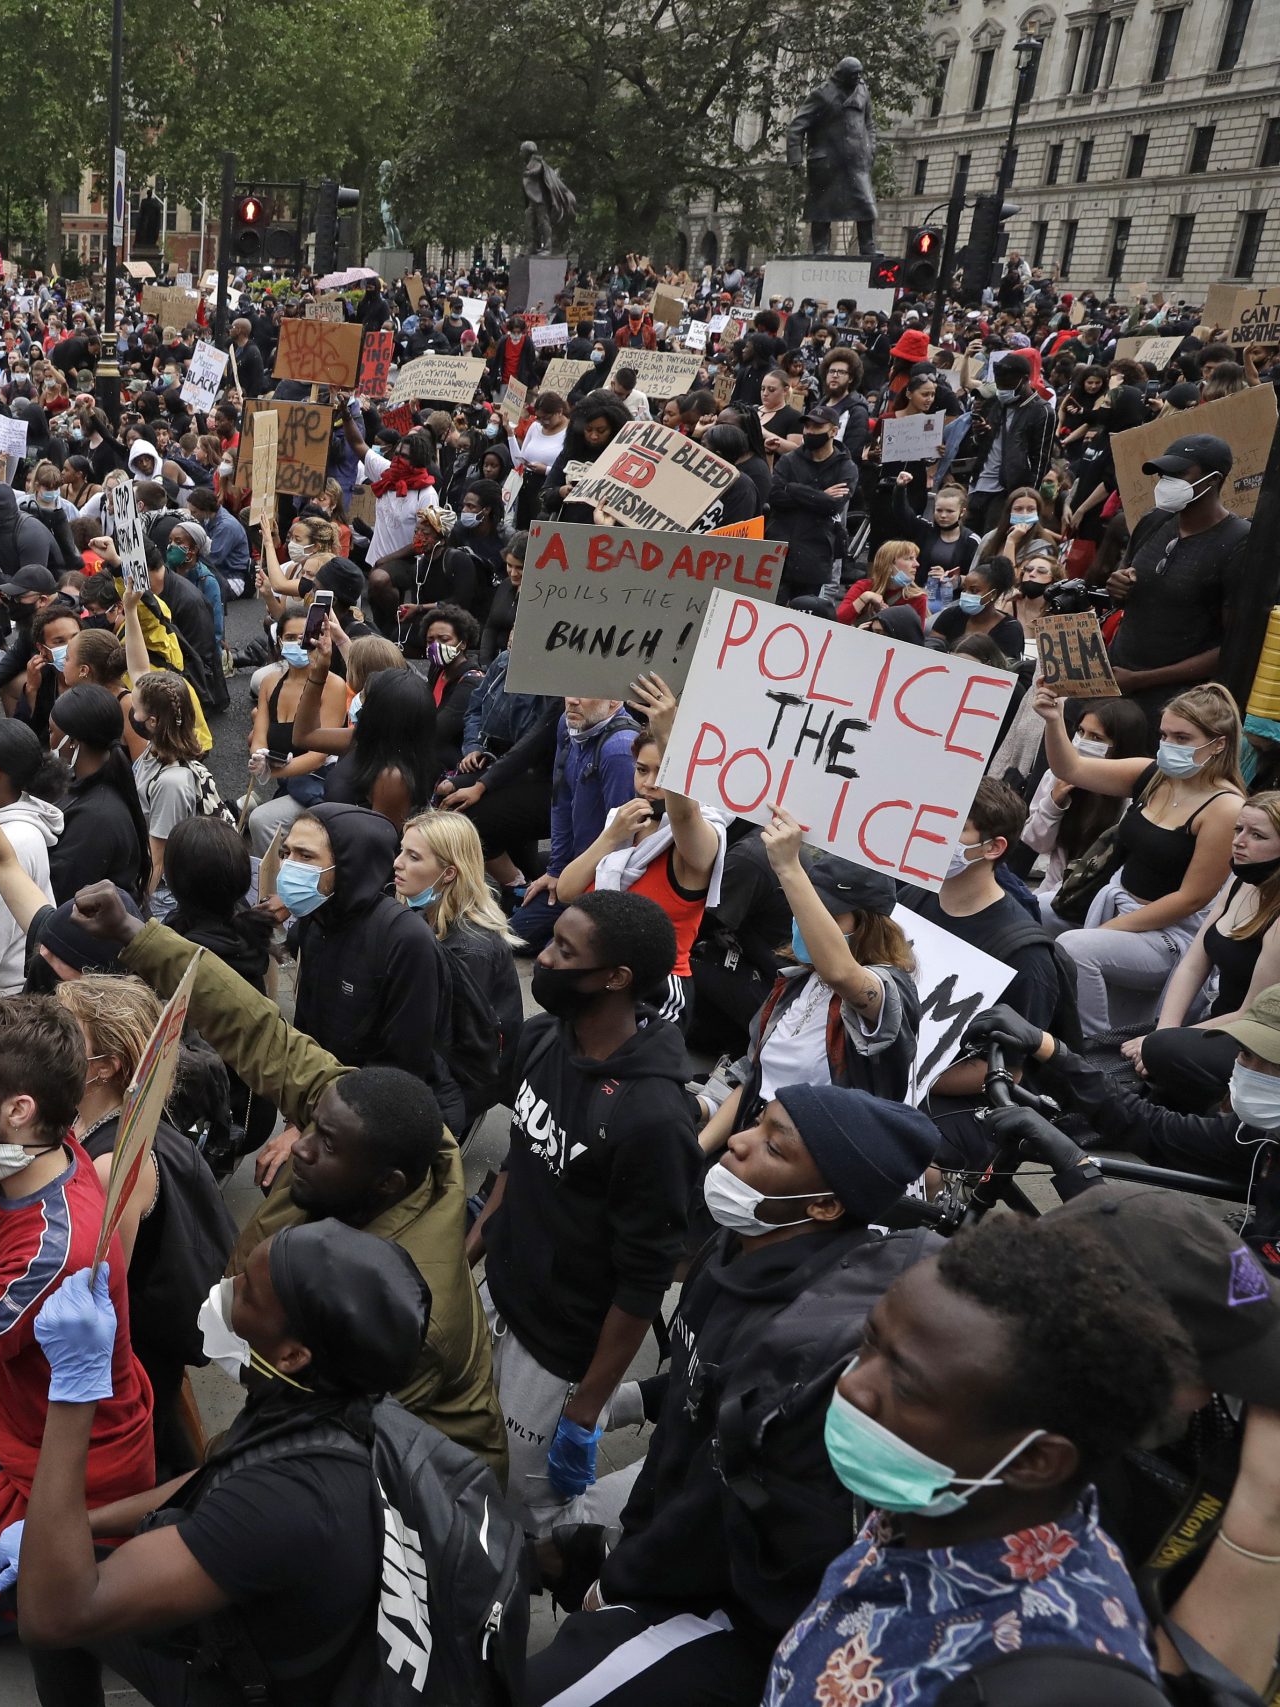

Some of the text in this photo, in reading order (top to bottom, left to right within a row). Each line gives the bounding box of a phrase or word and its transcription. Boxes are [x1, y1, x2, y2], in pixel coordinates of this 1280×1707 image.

[801, 269, 870, 284] CHURCH
[1255, 289, 1267, 306] I
[619, 350, 650, 360] JUSTICE
[186, 369, 217, 394] BLACK
[414, 379, 442, 387] STEPHEN
[425, 369, 457, 379] CYNTHIA
[606, 451, 657, 488] RED
[614, 421, 736, 489] WE ALL BLEED
[586, 534, 664, 572] BAD
[528, 581, 672, 609] SPOILS THE
[1039, 629, 1113, 684] BLM
[717, 598, 1013, 762] POLICE
[765, 689, 872, 779] THE
[684, 722, 960, 883] POLICE
[506, 1416, 546, 1446] NVLTY
[1178, 1492, 1223, 1538] Nikon
